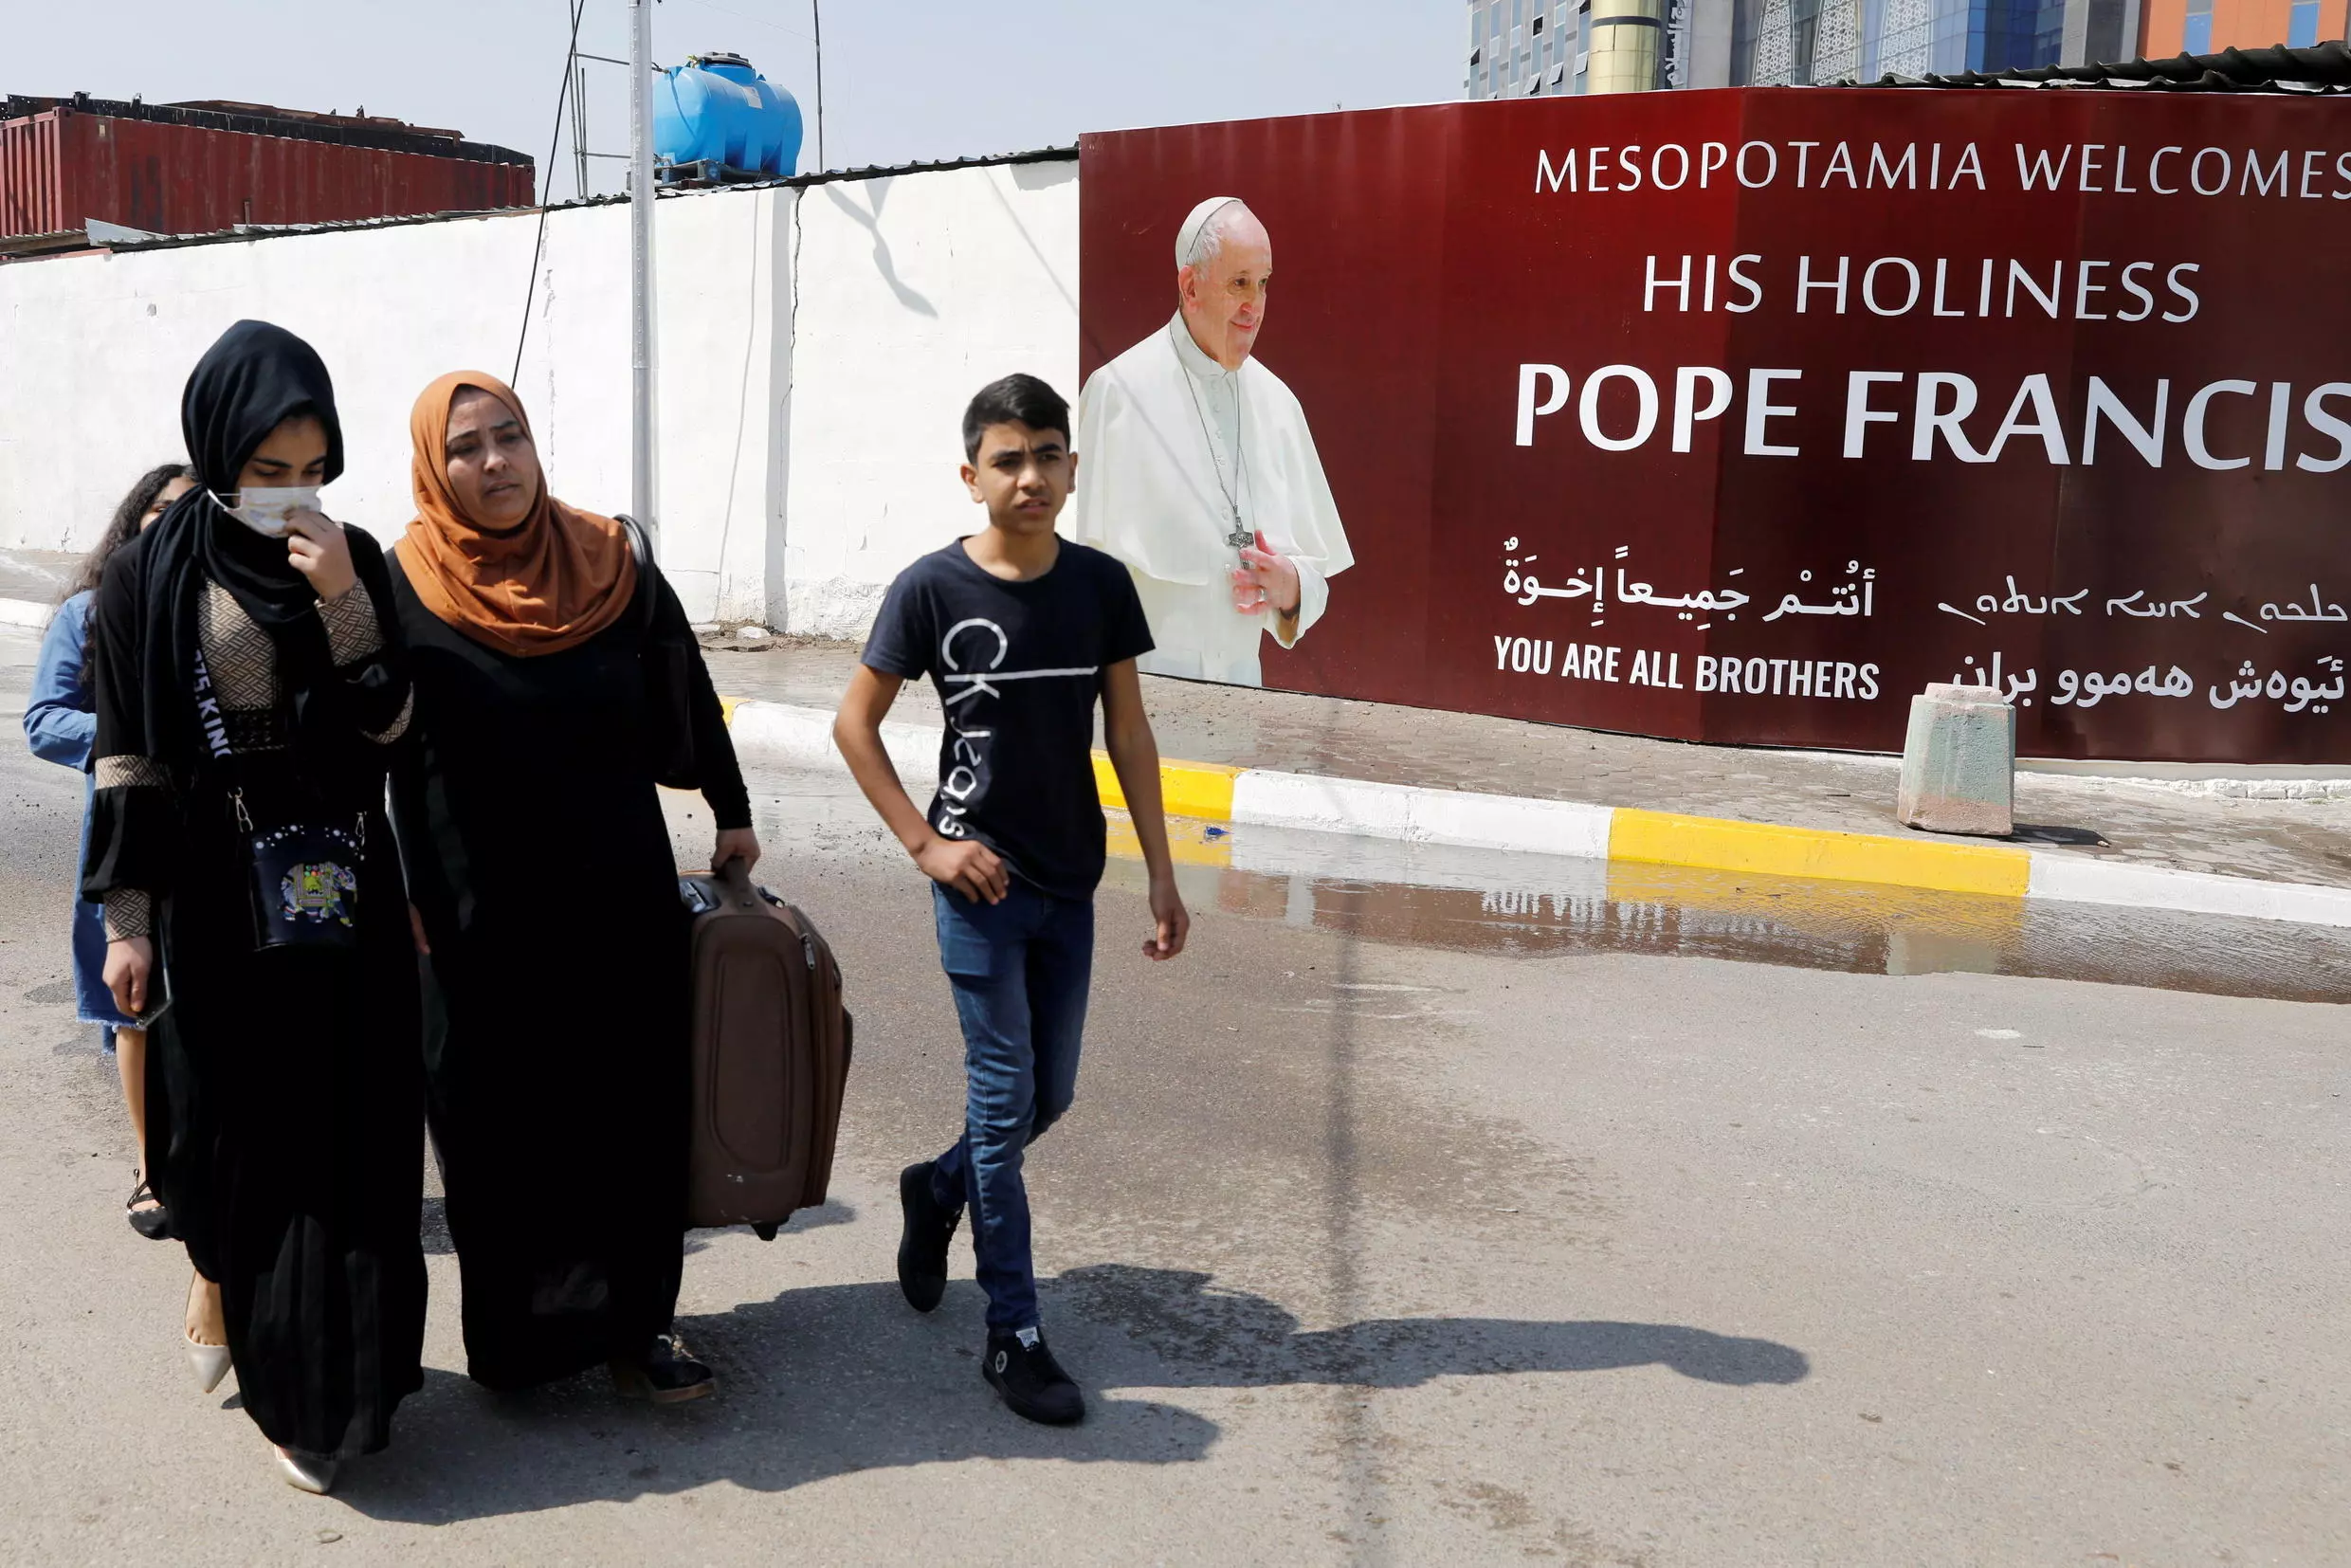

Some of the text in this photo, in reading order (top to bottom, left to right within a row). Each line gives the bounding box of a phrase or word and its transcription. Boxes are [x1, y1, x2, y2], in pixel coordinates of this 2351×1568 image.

[1534, 140, 2351, 200] MESOPOTAMIA WELCOMES
[1643, 253, 2200, 323] HIS HOLINESS
[1515, 363, 2351, 473] POPE FRANCIS
[1493, 635, 1880, 701] YOU ARE ALL BROTHERS
